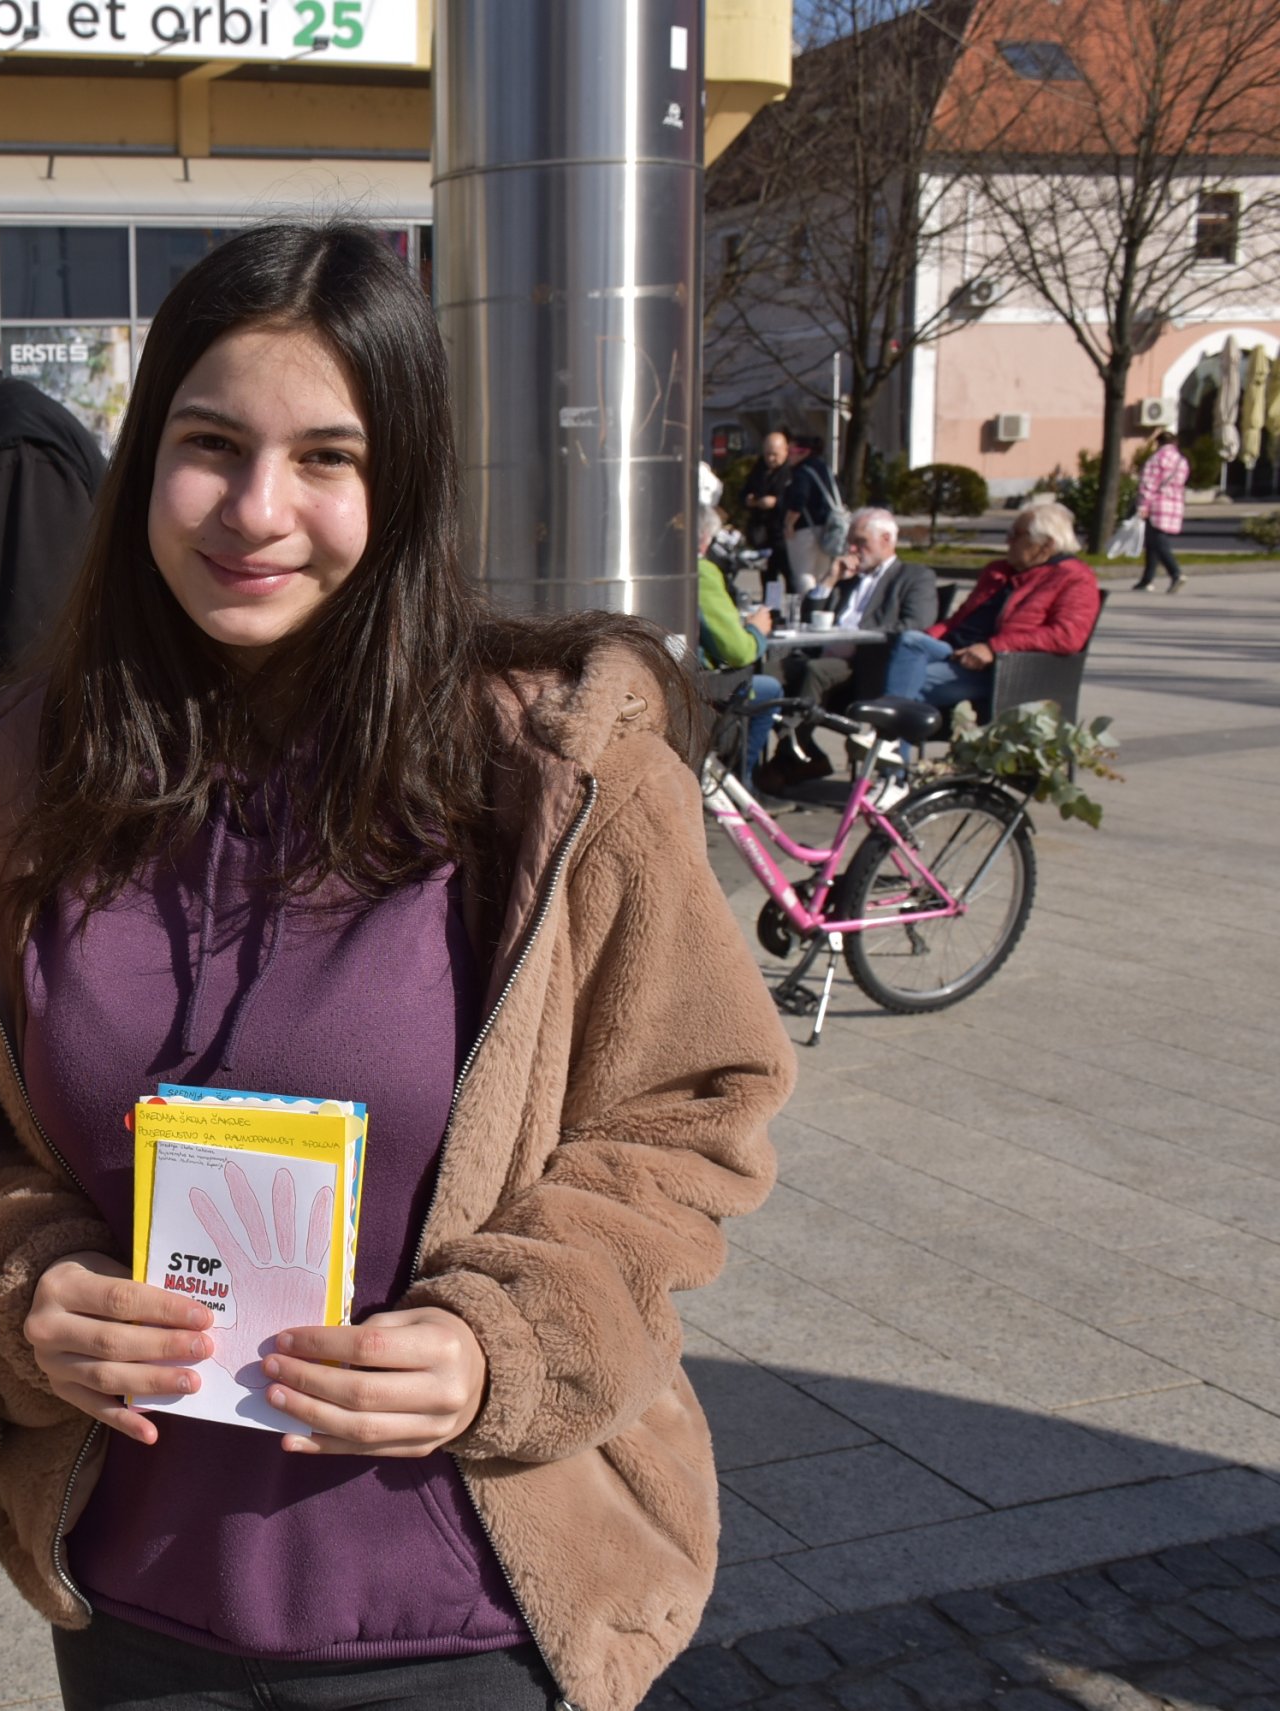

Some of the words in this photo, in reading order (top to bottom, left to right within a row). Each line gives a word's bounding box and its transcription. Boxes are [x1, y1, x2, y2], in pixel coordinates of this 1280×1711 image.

[68, 0, 127, 40] et
[151, 0, 269, 46] orbi
[293, 0, 364, 49] 25
[10, 343, 68, 362] ERSTE
[167, 1251, 222, 1277] STOP
[164, 1273, 229, 1299] NASILJU
[191, 1295, 227, 1313] NAMA
